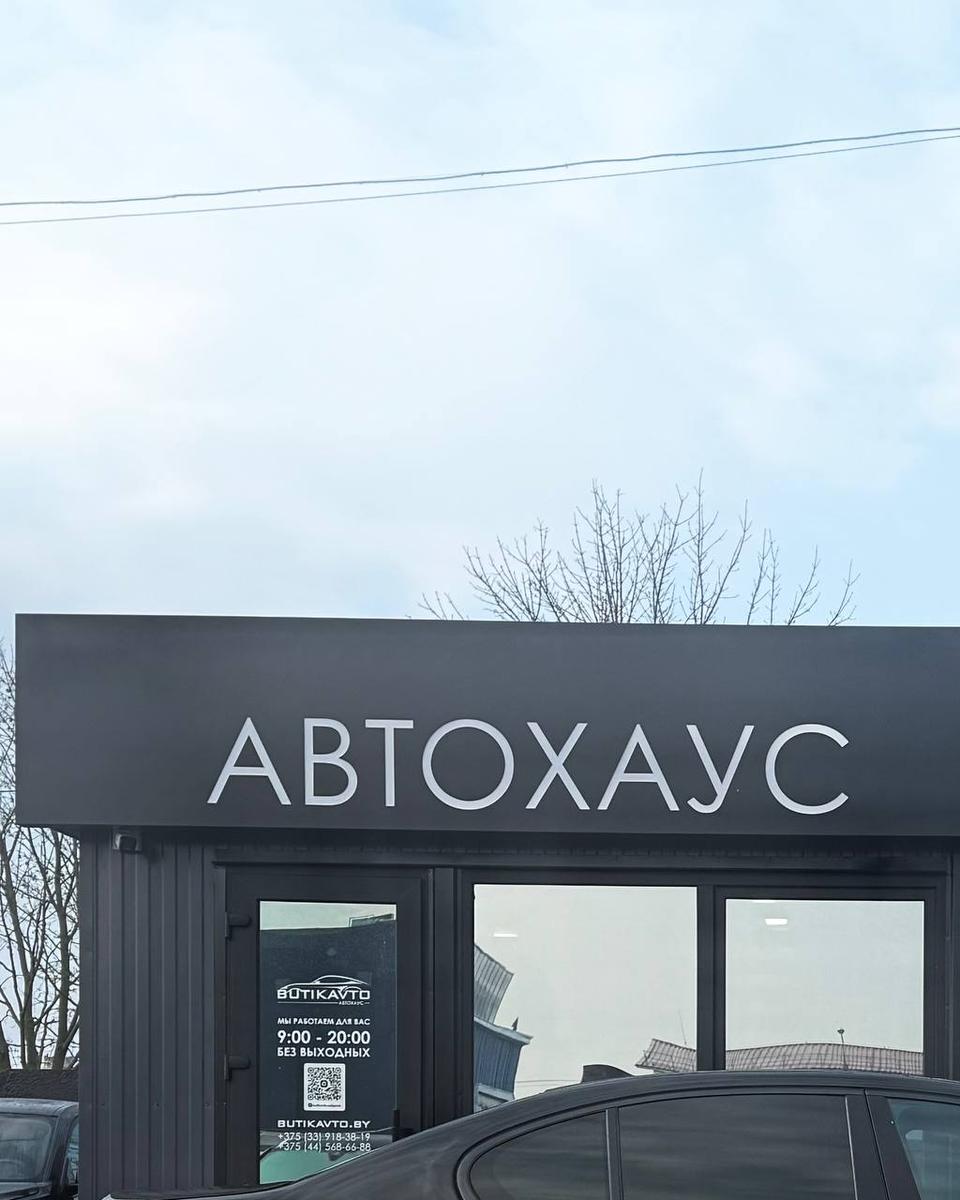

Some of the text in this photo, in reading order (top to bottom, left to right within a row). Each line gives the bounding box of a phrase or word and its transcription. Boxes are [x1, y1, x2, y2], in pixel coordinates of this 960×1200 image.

[207, 716, 850, 815] АВТОХАУС
[277, 989, 370, 1000] BUTIKAVTO
[277, 1017, 371, 1026] МЫ РАБОТАЕМ ДЛЯ ВАС
[277, 1029, 311, 1044] 9:00
[327, 1030, 371, 1045] 20:00
[277, 1046, 371, 1059] БЕЗ ВЫХОДНЫХ
[277, 1119, 371, 1129] BUTIKAVTO.BY
[278, 1132, 371, 1143] +375 (33) 918-38-19
[303, 1142, 322, 1153] (44)
[324, 1142, 371, 1151] 568-66-88
